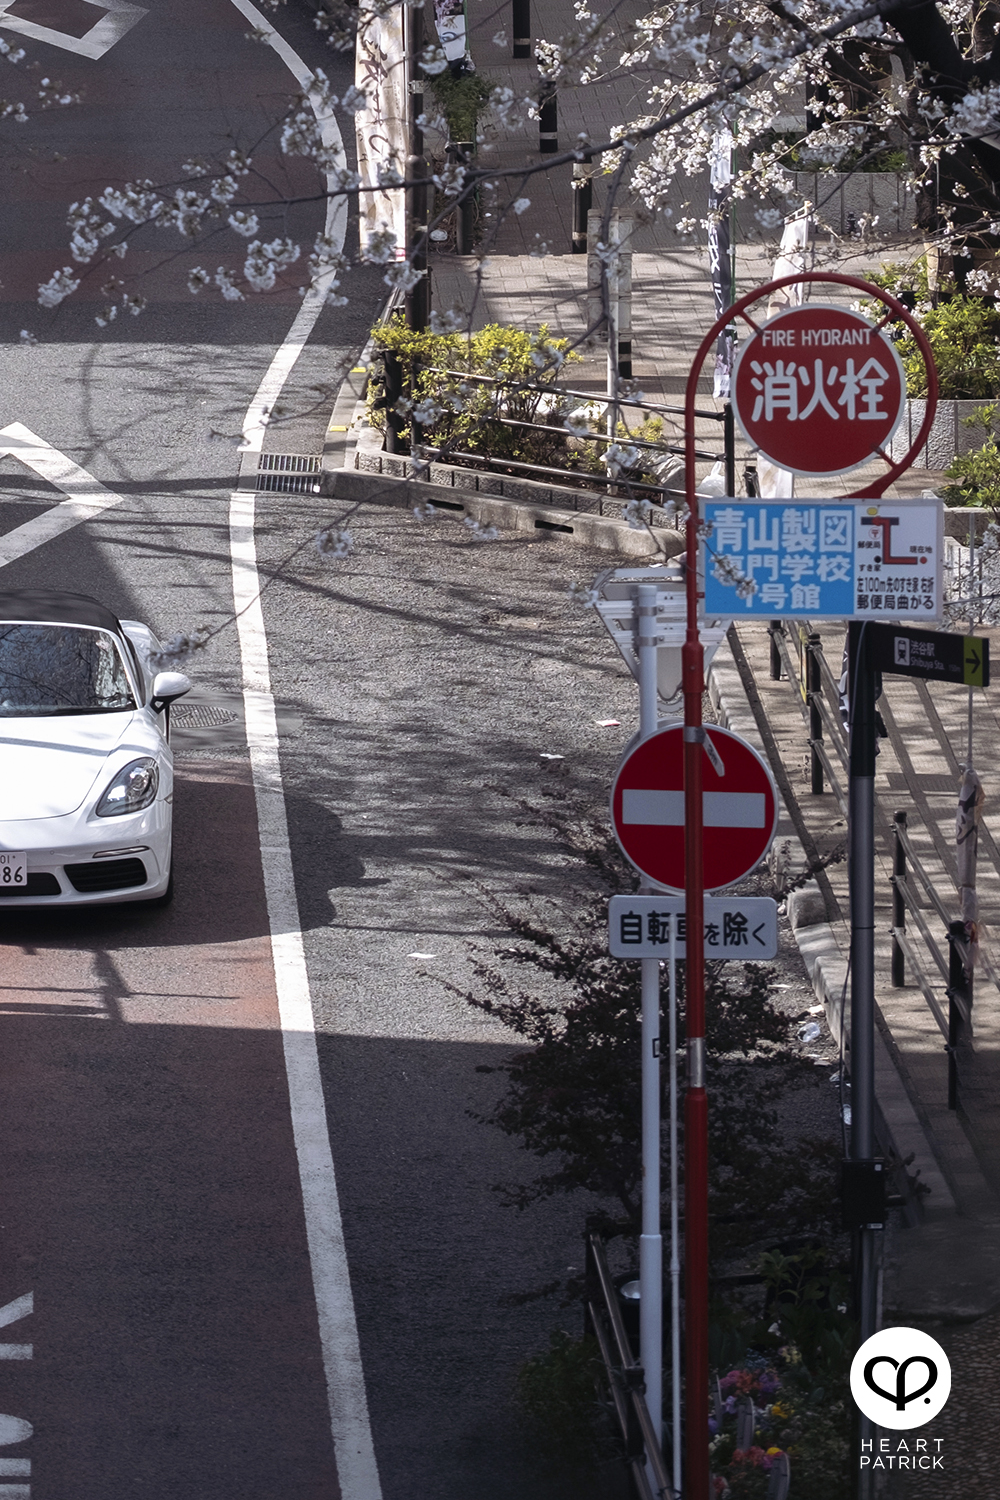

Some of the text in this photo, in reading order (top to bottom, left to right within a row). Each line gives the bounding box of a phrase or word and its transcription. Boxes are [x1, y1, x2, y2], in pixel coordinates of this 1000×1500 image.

[762, 328, 871, 347] FIRE HYDRANT
[750, 357, 890, 422] 消火栓
[712, 508, 853, 553] 青山製図
[909, 545, 933, 553] 現在地
[859, 564, 881, 572] すき家
[857, 595, 934, 610] 郵便局曲がる
[911, 640, 935, 657] 渋谷駅
[911, 656, 934, 671] Shibuya
[934, 659, 945, 670] Sta.
